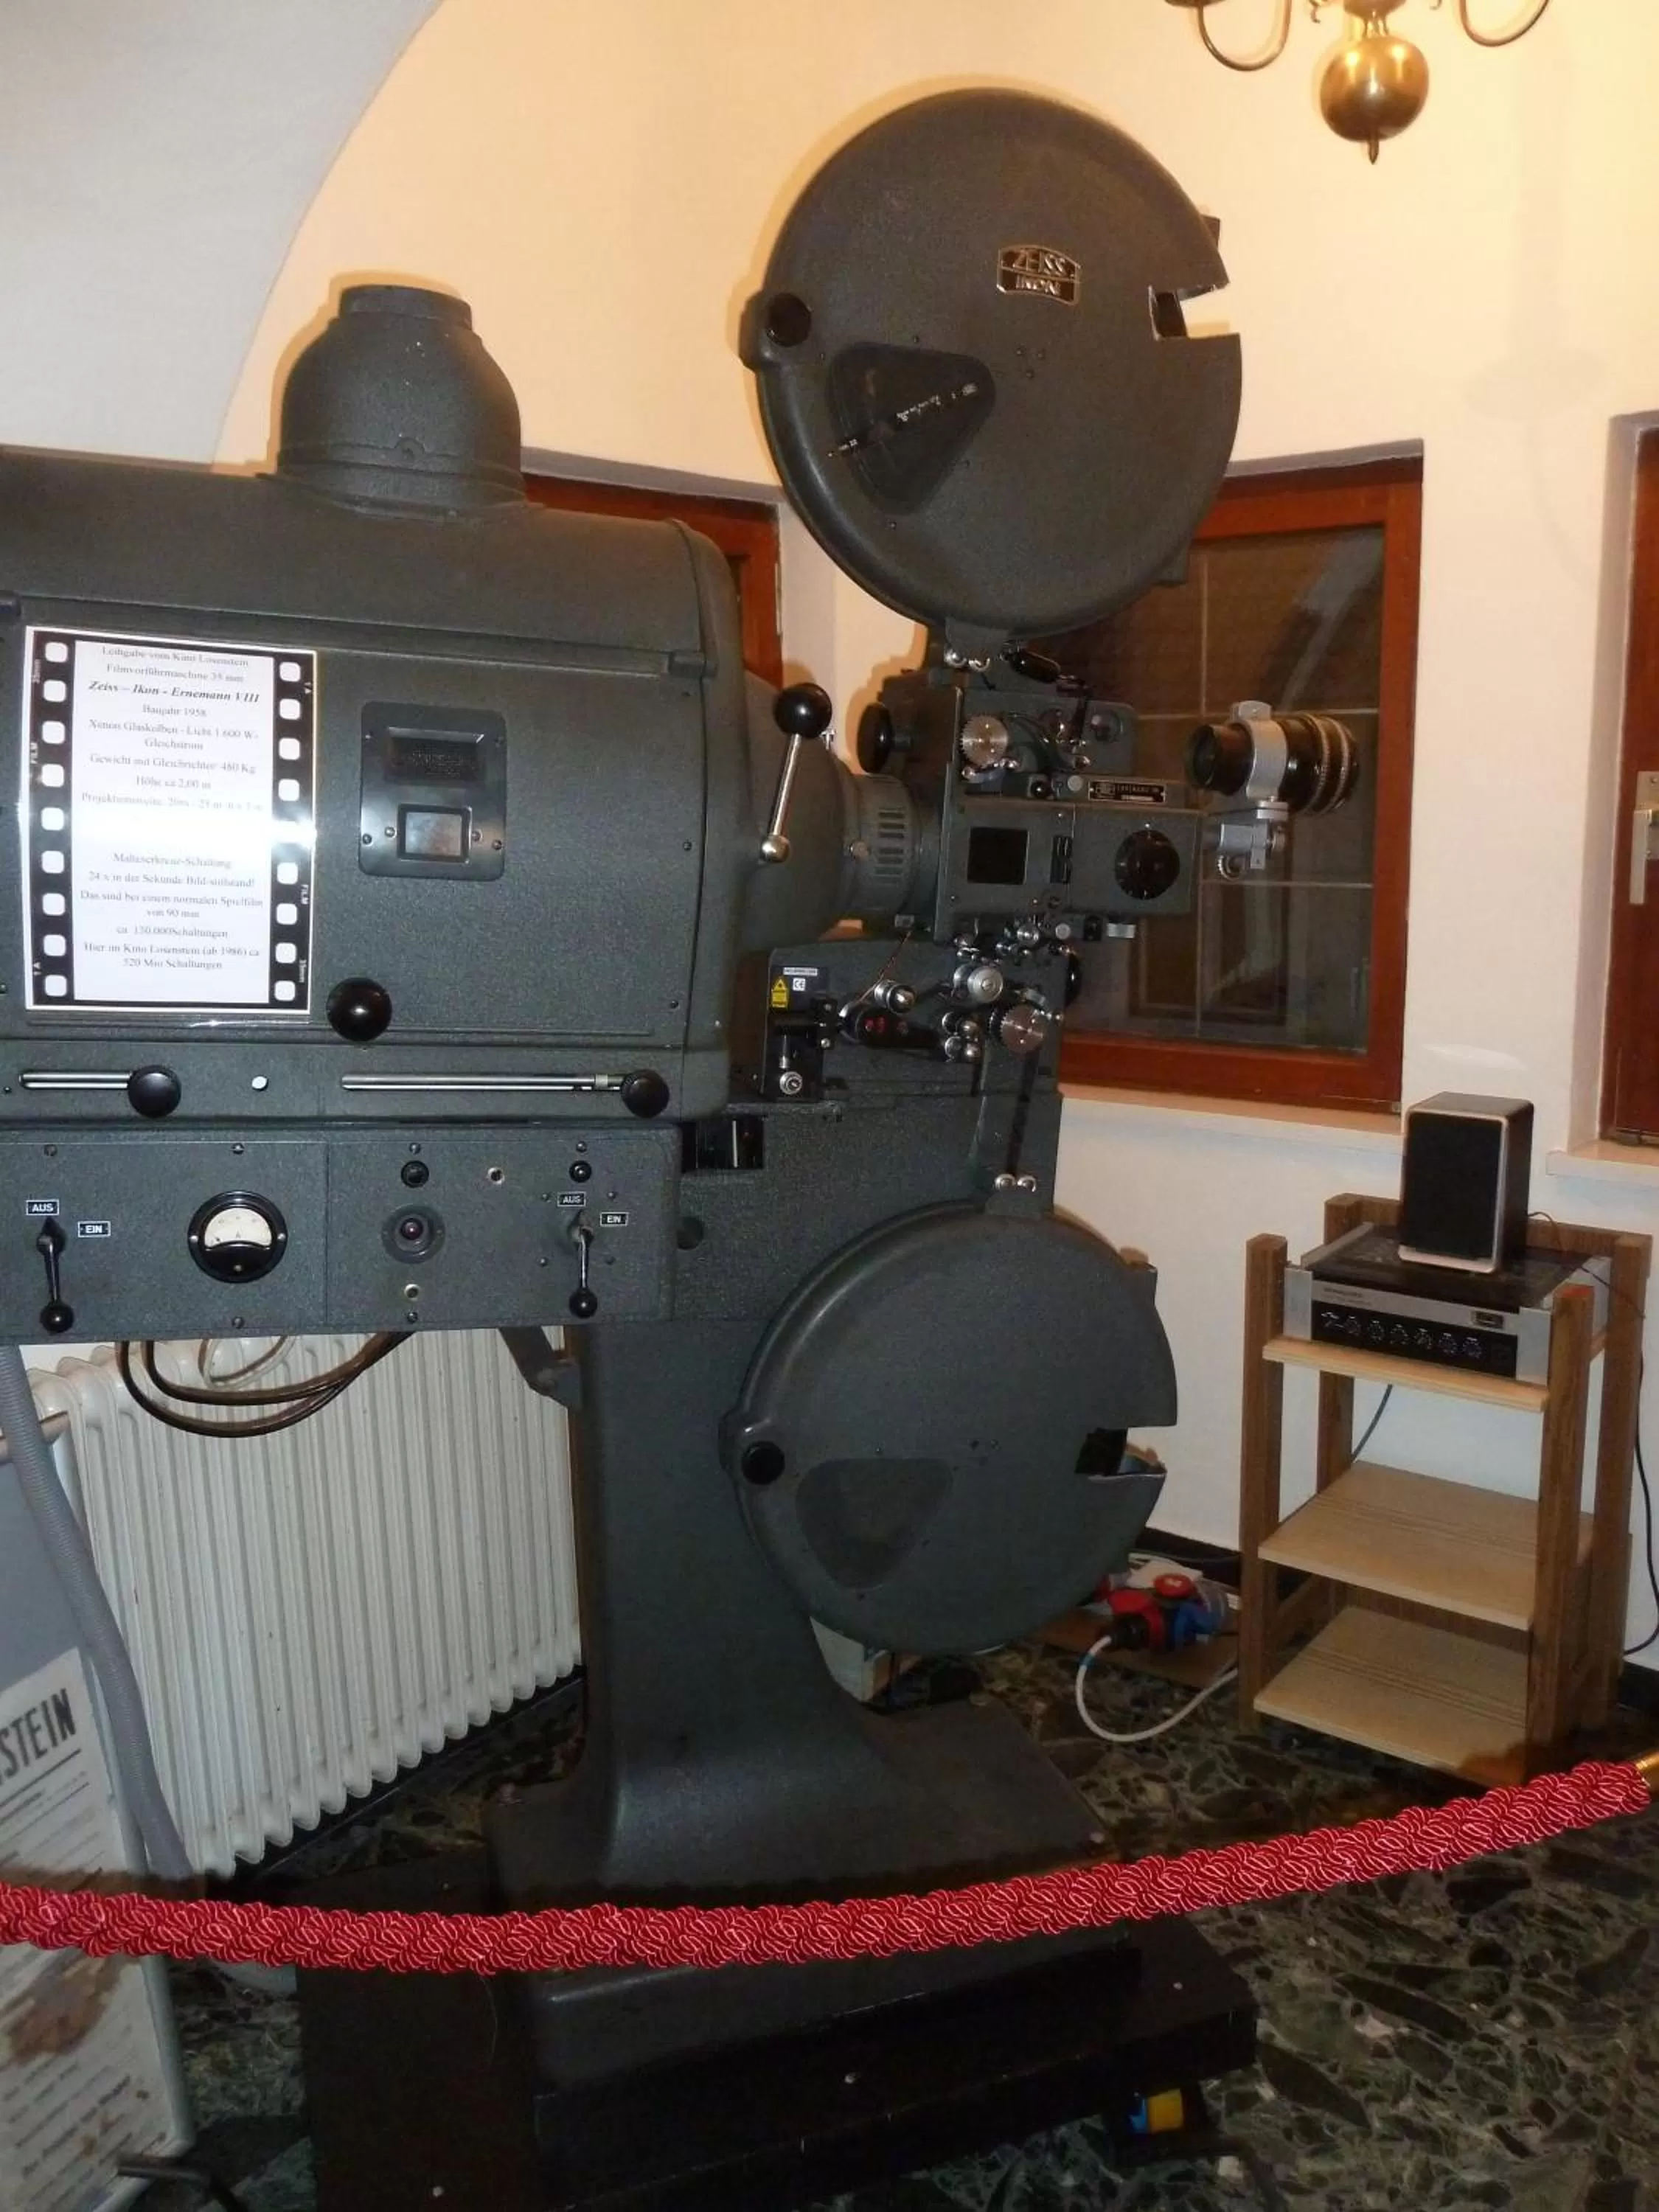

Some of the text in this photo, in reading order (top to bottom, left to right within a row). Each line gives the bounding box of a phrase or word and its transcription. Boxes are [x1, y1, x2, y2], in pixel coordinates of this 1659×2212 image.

[1013, 249, 1068, 276] ZEISS
[1015, 274, 1062, 296] IKON
[88, 680, 119, 692] Zeiss
[133, 683, 160, 695] Ikon
[171, 686, 231, 700] Ernemann
[234, 691, 260, 703] VIII
[563, 1194, 582, 1204] AUS
[32, 1202, 54, 1213] AUS
[607, 1214, 622, 1223] EIN
[85, 1225, 103, 1234] EIN
[0, 1687, 77, 1785] STEIN
